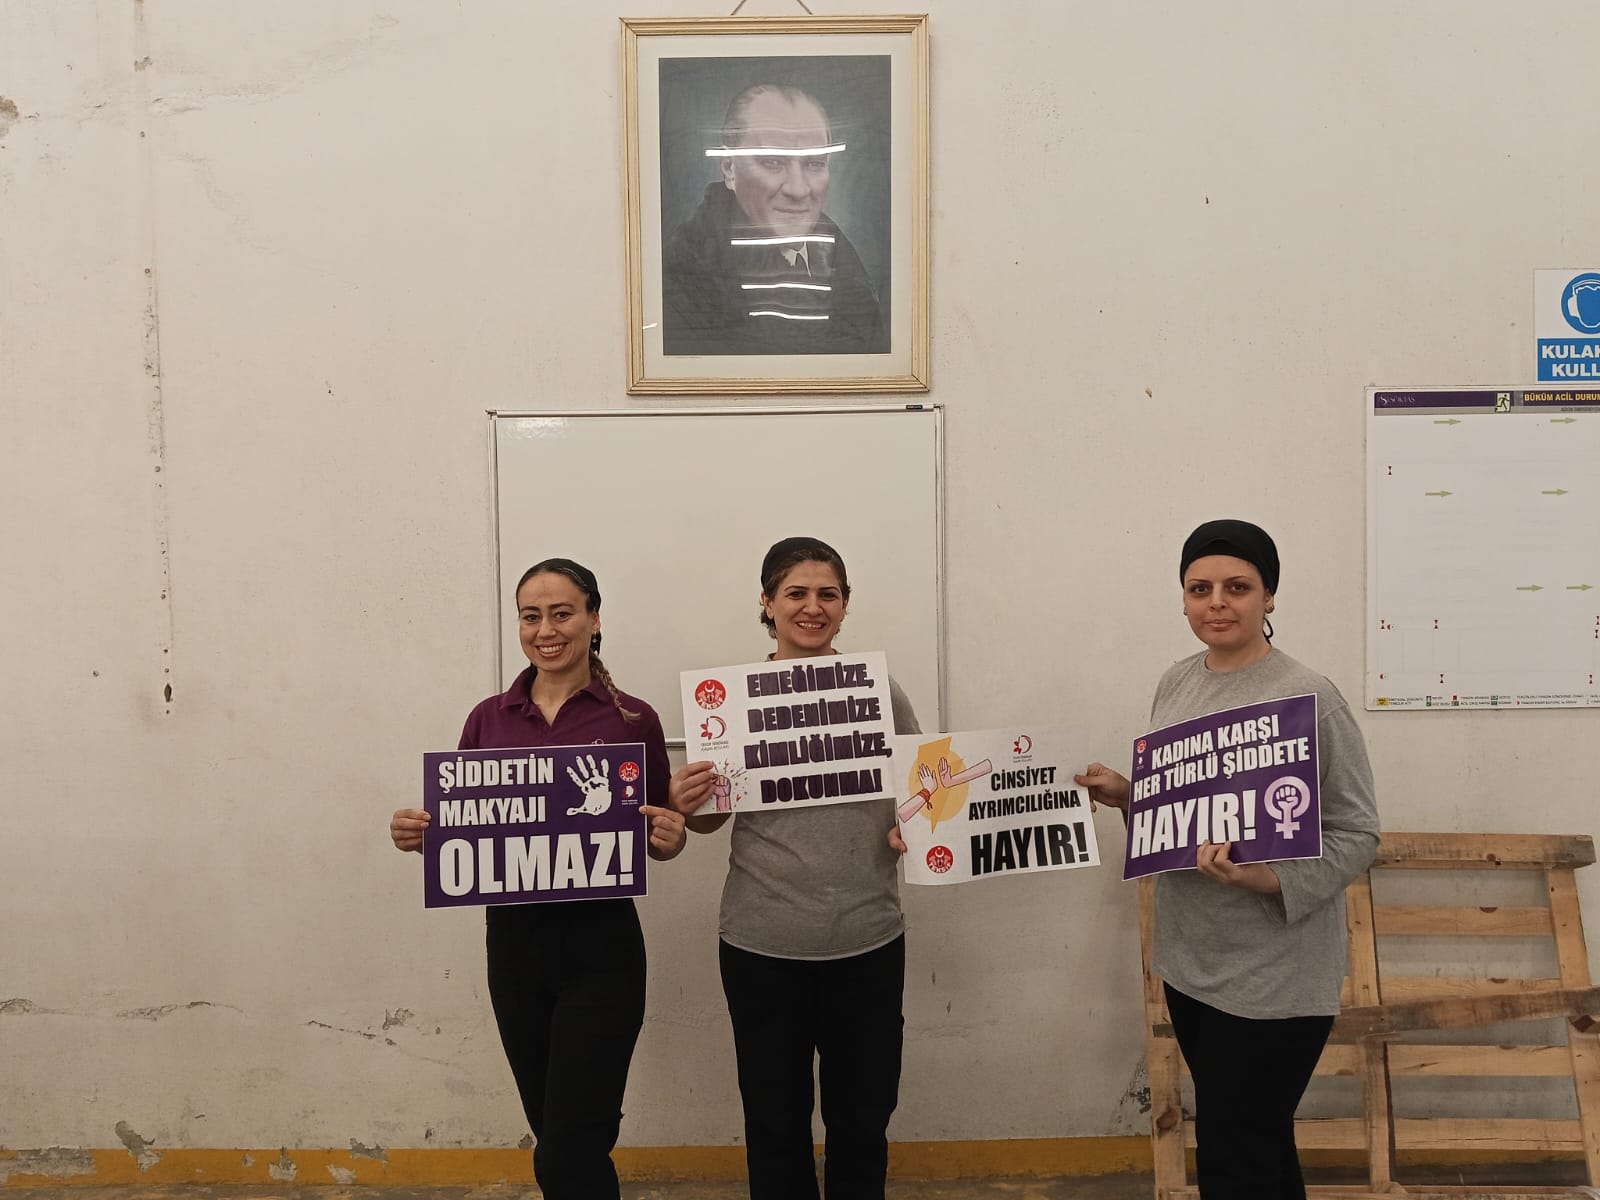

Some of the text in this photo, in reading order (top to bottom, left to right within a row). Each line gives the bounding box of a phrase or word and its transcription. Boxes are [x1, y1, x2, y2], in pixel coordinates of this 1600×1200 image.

[1551, 363, 1600, 377] KULL
[1524, 392, 1553, 401] BÜKÜM
[1555, 391, 1573, 401] ACİL
[746, 661, 875, 698] EMEĞİMİZE,
[747, 695, 882, 733] BEDENİMİZE
[743, 730, 893, 770] KİMLİĞİMİZE,
[1151, 714, 1280, 771] KADINA KARŞI
[438, 753, 554, 794] ŞİDDETİN
[990, 765, 1057, 792] CİNSİYET
[1133, 736, 1311, 803] HER TÜRLÜ ŞİDDETE
[439, 796, 546, 827] MAKYAJI
[968, 789, 1082, 821] AYRIMCILIĞINA
[1130, 789, 1257, 860] HAYIR!
[439, 830, 634, 897] OLMAZ!
[970, 821, 1090, 877] HAYIR!
